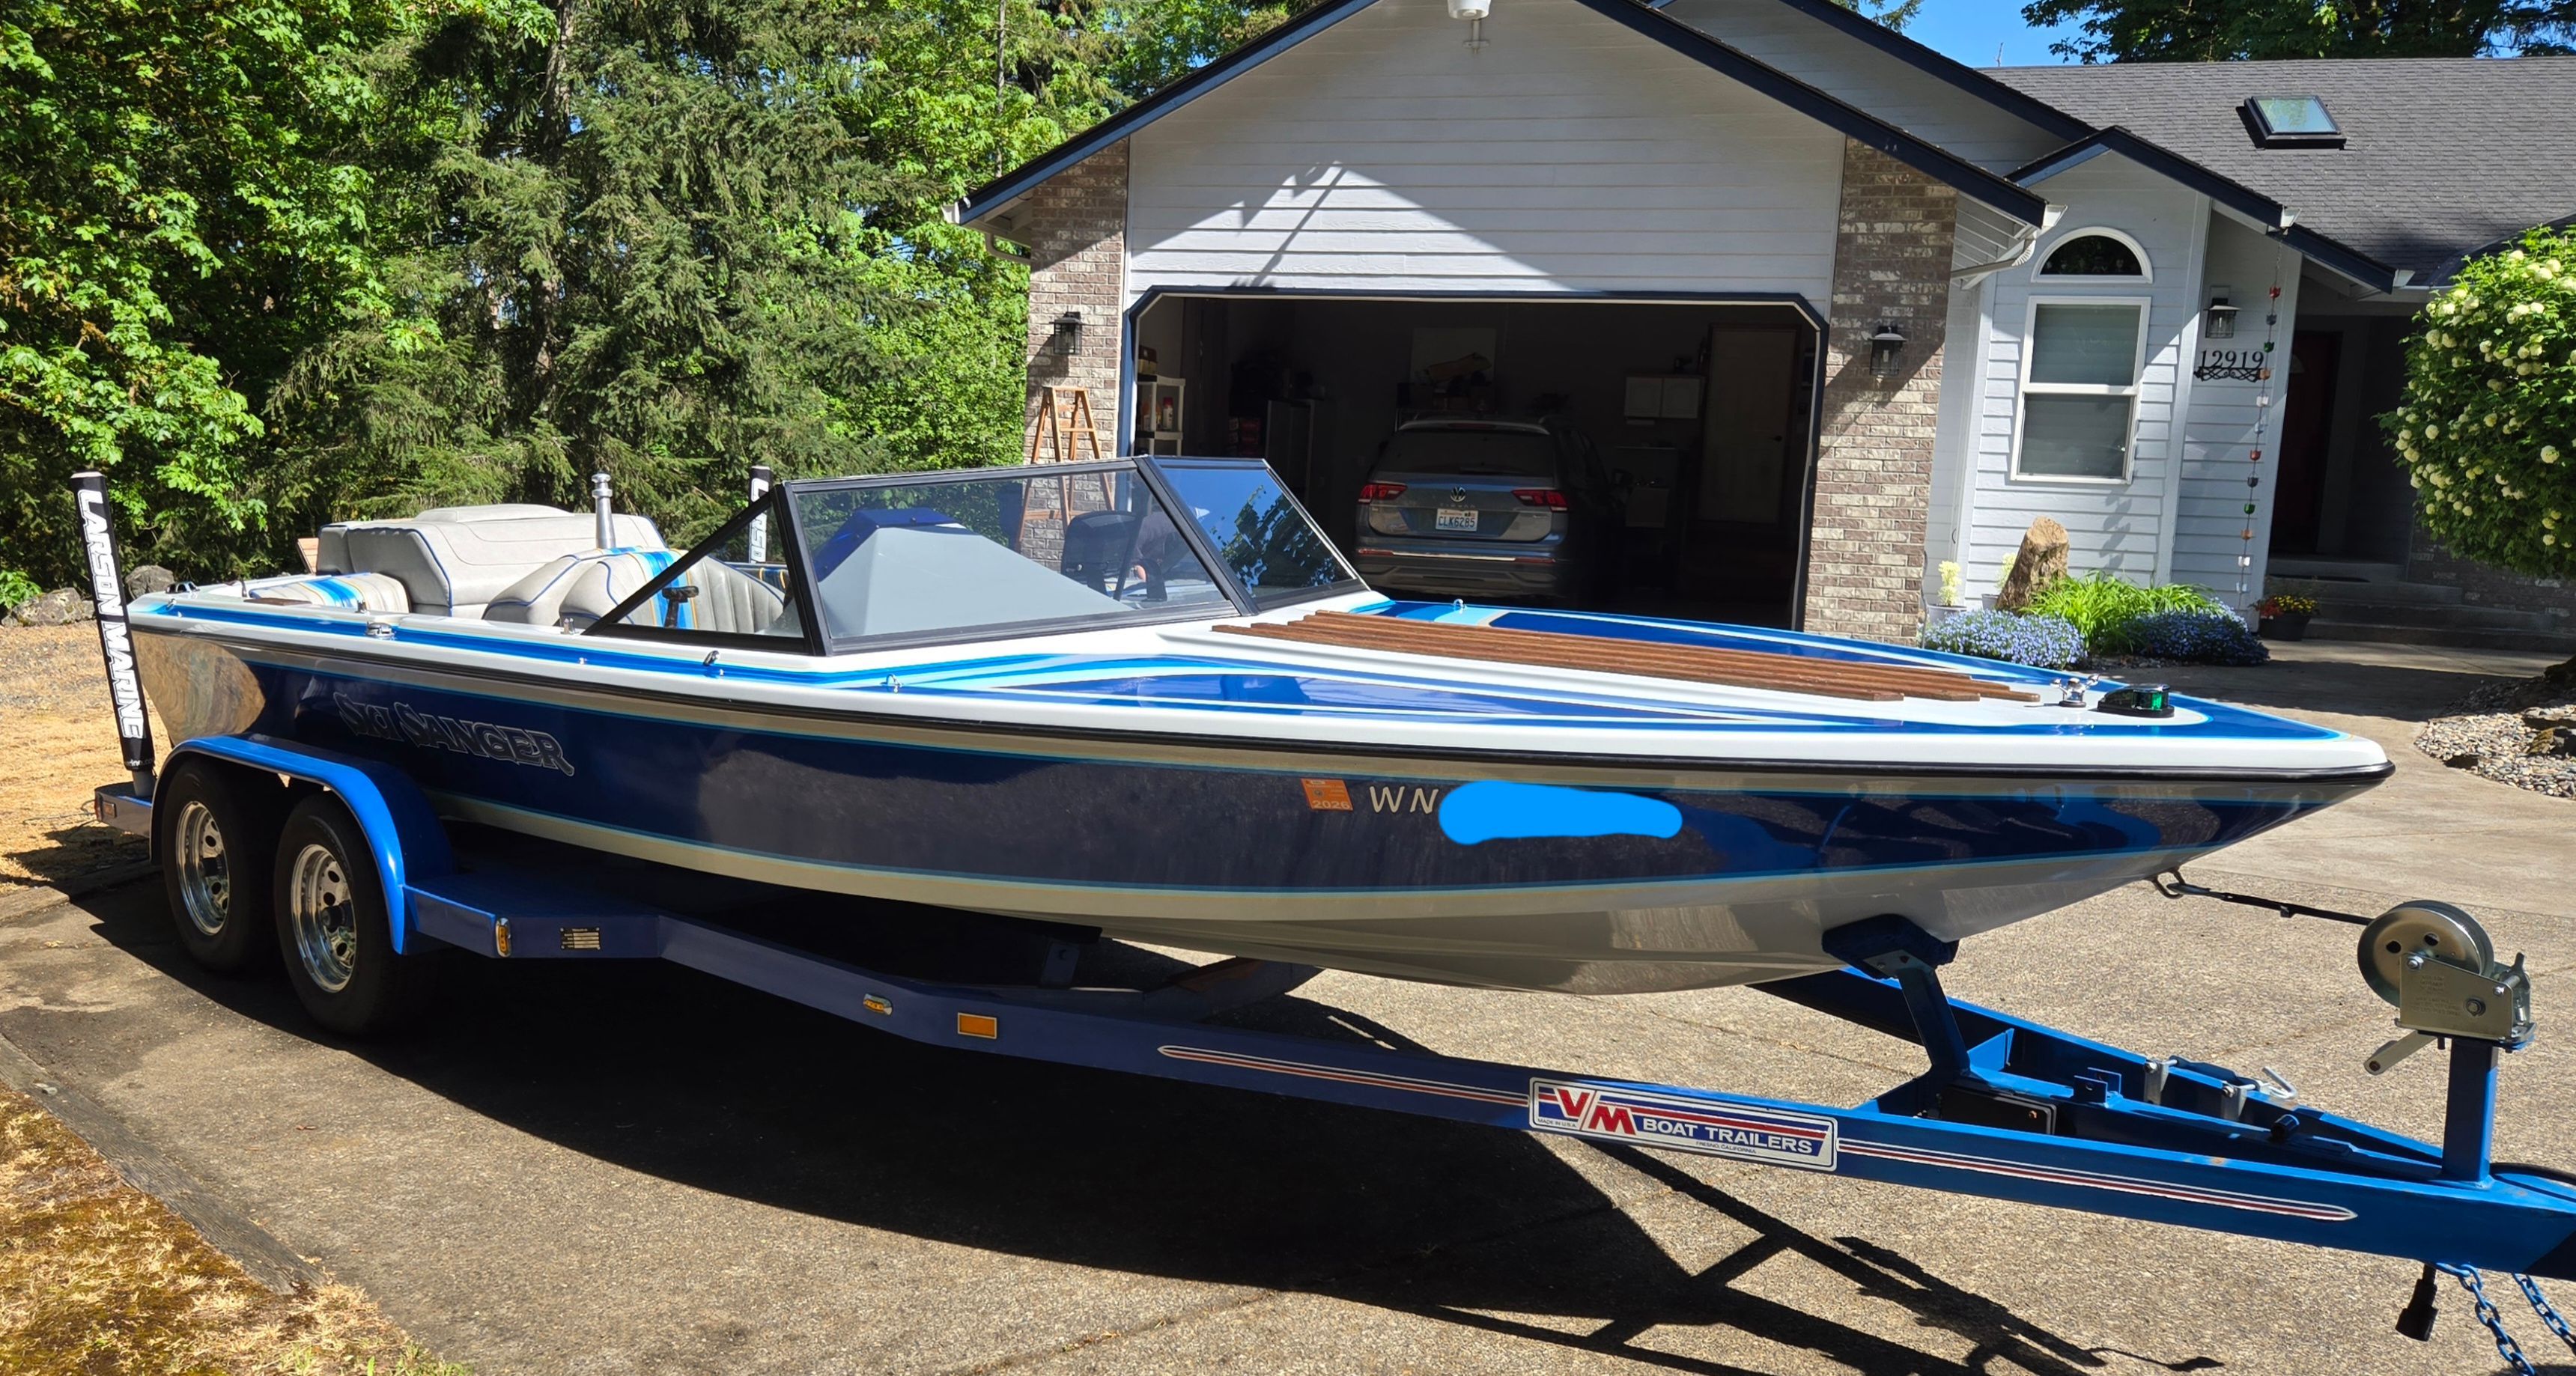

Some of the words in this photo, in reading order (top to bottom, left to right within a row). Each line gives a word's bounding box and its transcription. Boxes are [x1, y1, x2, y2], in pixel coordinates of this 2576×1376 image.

[2202, 350, 2264, 370] 12919
[1438, 516, 1476, 528] CLK6285
[78, 489, 124, 617] LARSON
[100, 621, 146, 740] MARINE
[1312, 800, 1351, 810] 2026
[1557, 1088, 1636, 1135] VM
[1643, 1118, 1698, 1137] BOAT
[1704, 1126, 1813, 1154] TRAILERS
[1721, 1143, 1757, 1154] CALIFORNIA
